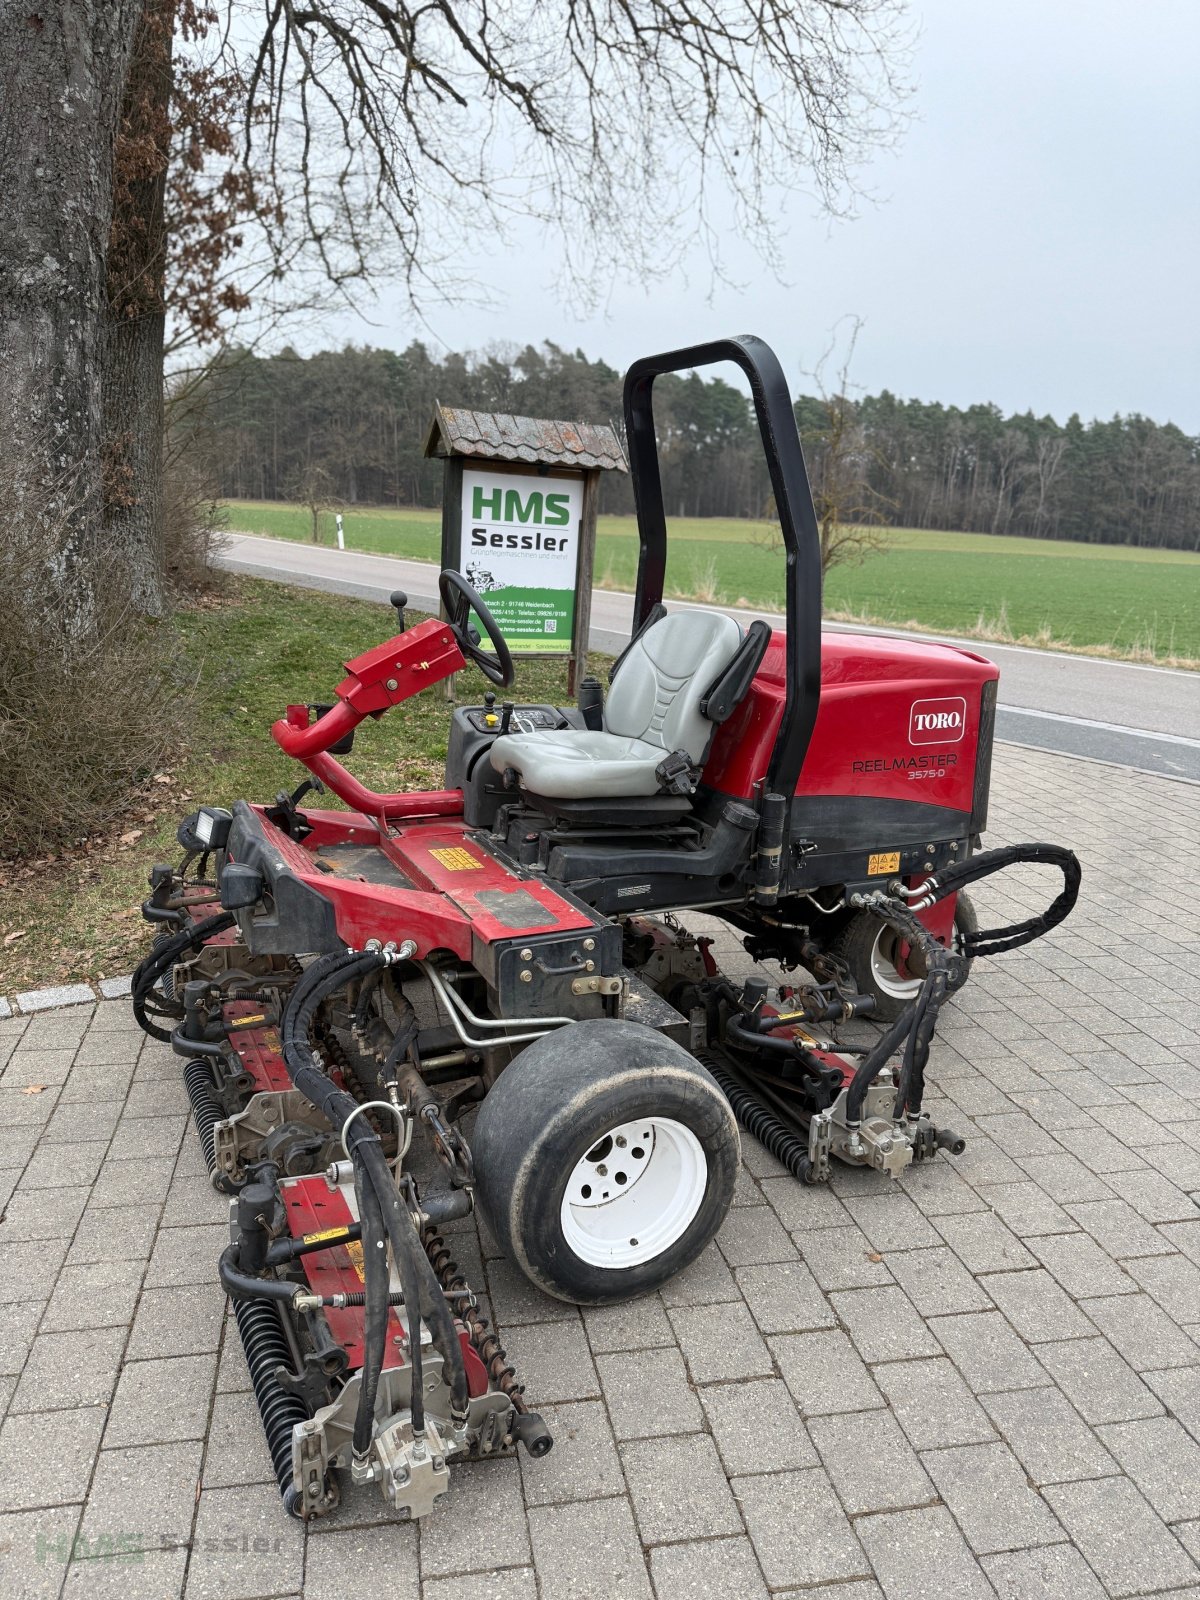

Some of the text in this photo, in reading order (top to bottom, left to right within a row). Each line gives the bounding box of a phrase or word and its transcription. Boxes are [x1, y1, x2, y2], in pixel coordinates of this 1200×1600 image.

[472, 486, 570, 526] HMS
[471, 528, 568, 552] Sessler
[914, 711, 961, 731] TORO
[852, 754, 958, 773] REELMASTER
